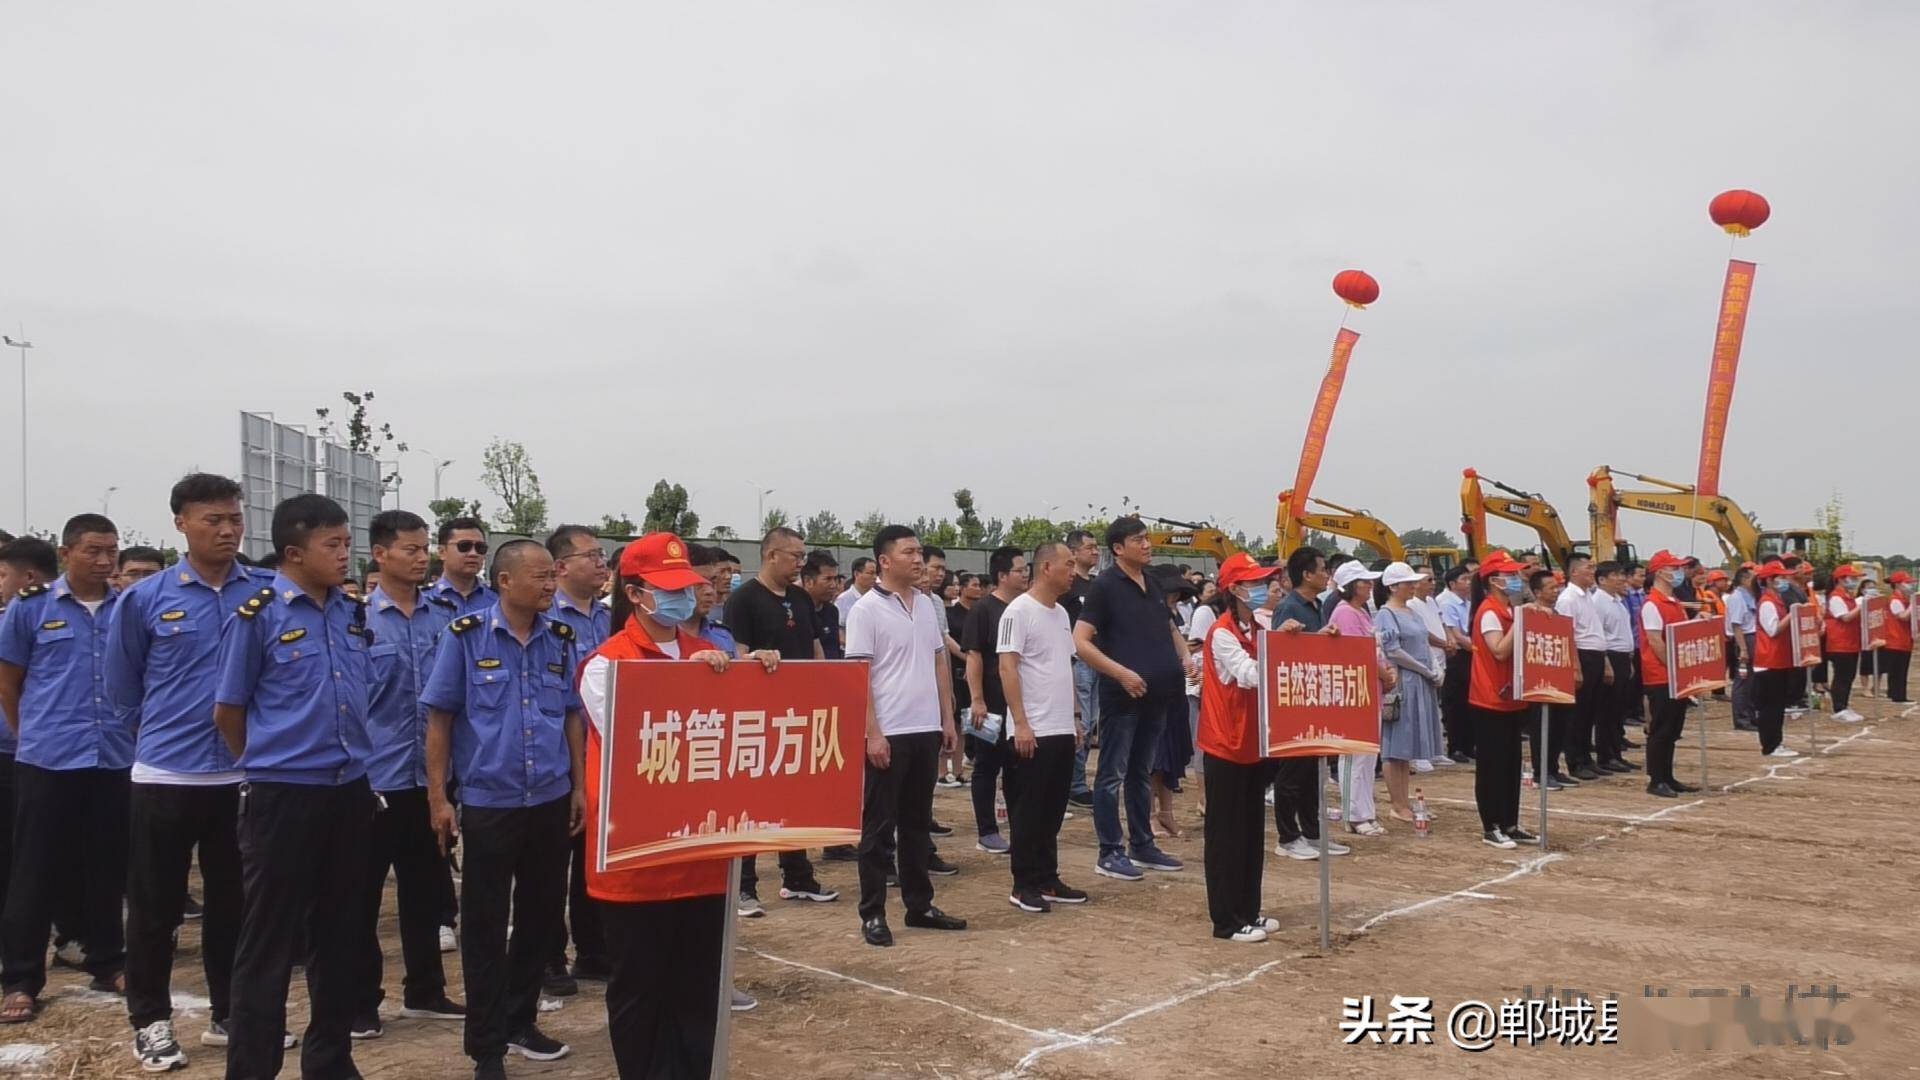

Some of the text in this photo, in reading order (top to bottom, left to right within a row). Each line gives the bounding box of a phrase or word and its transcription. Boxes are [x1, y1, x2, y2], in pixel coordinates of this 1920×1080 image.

[1508, 504, 1529, 516] SANY
[1637, 499, 1676, 512] KOMATSU
[1171, 535, 1192, 545] SANY
[1526, 630, 1572, 669] 发改委方队
[1277, 660, 1371, 708] 自然资源局方队
[636, 706, 845, 785] 城管局方队
